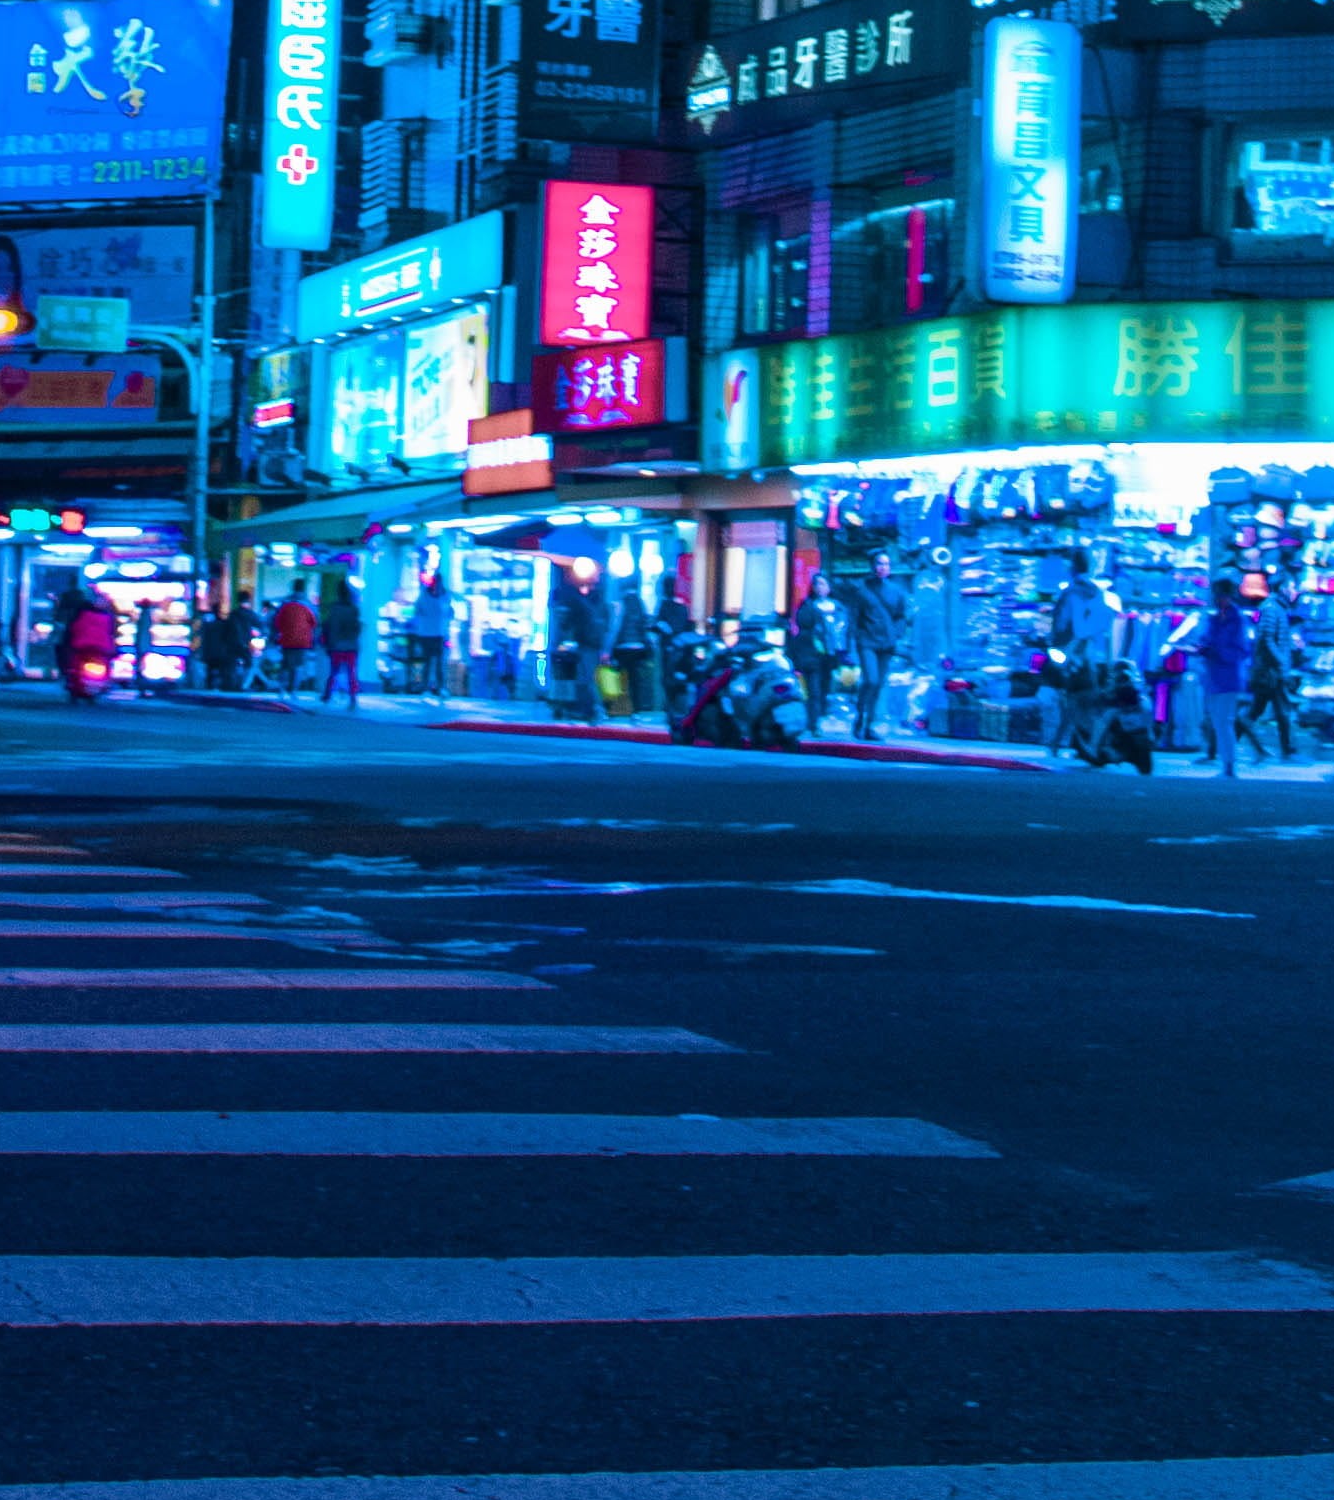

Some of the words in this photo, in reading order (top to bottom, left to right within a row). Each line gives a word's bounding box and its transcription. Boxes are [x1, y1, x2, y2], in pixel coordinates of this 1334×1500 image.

[735, 9, 915, 106] 成品牙醫診所
[93, 157, 208, 185] 2211-1234
[574, 193, 622, 330] 金莎珠寶
[554, 350, 643, 411] 金莎珠寶
